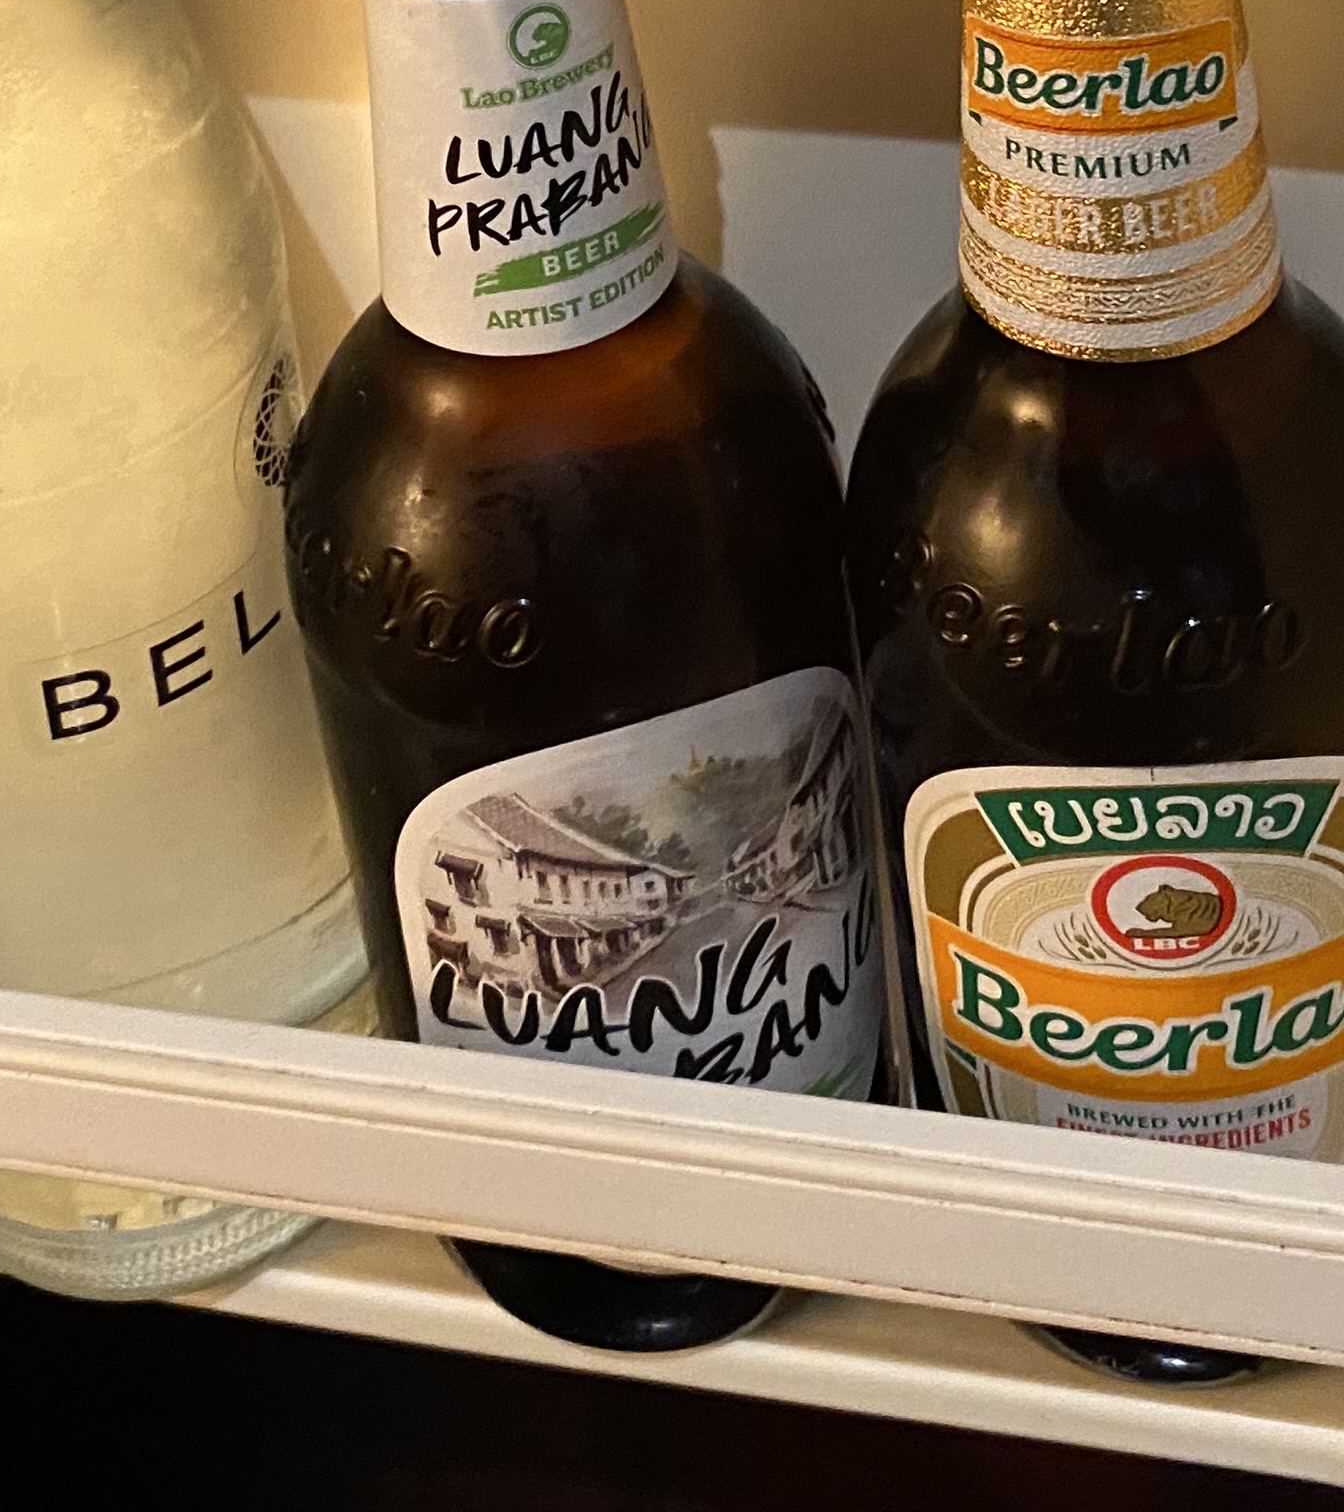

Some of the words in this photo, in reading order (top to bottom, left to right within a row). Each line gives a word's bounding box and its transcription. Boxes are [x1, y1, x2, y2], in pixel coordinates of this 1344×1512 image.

[461, 87, 515, 109] Lao
[518, 40, 613, 101] Brewery
[973, 37, 1225, 110] Beerlao
[445, 71, 629, 184] LUANG
[1005, 138, 1191, 179] PREMIUM
[542, 229, 621, 277] BEER
[486, 299, 582, 330] ARTIST
[588, 245, 666, 309] EDITION
[1007, 794, 1305, 848] ເບຍລາວ
[1133, 936, 1201, 951] LBC
[429, 914, 793, 1055] LUANG
[1067, 1103, 1168, 1129] BREWED
[1177, 1109, 1243, 1129] WITH
[1255, 1094, 1296, 1119] THE
